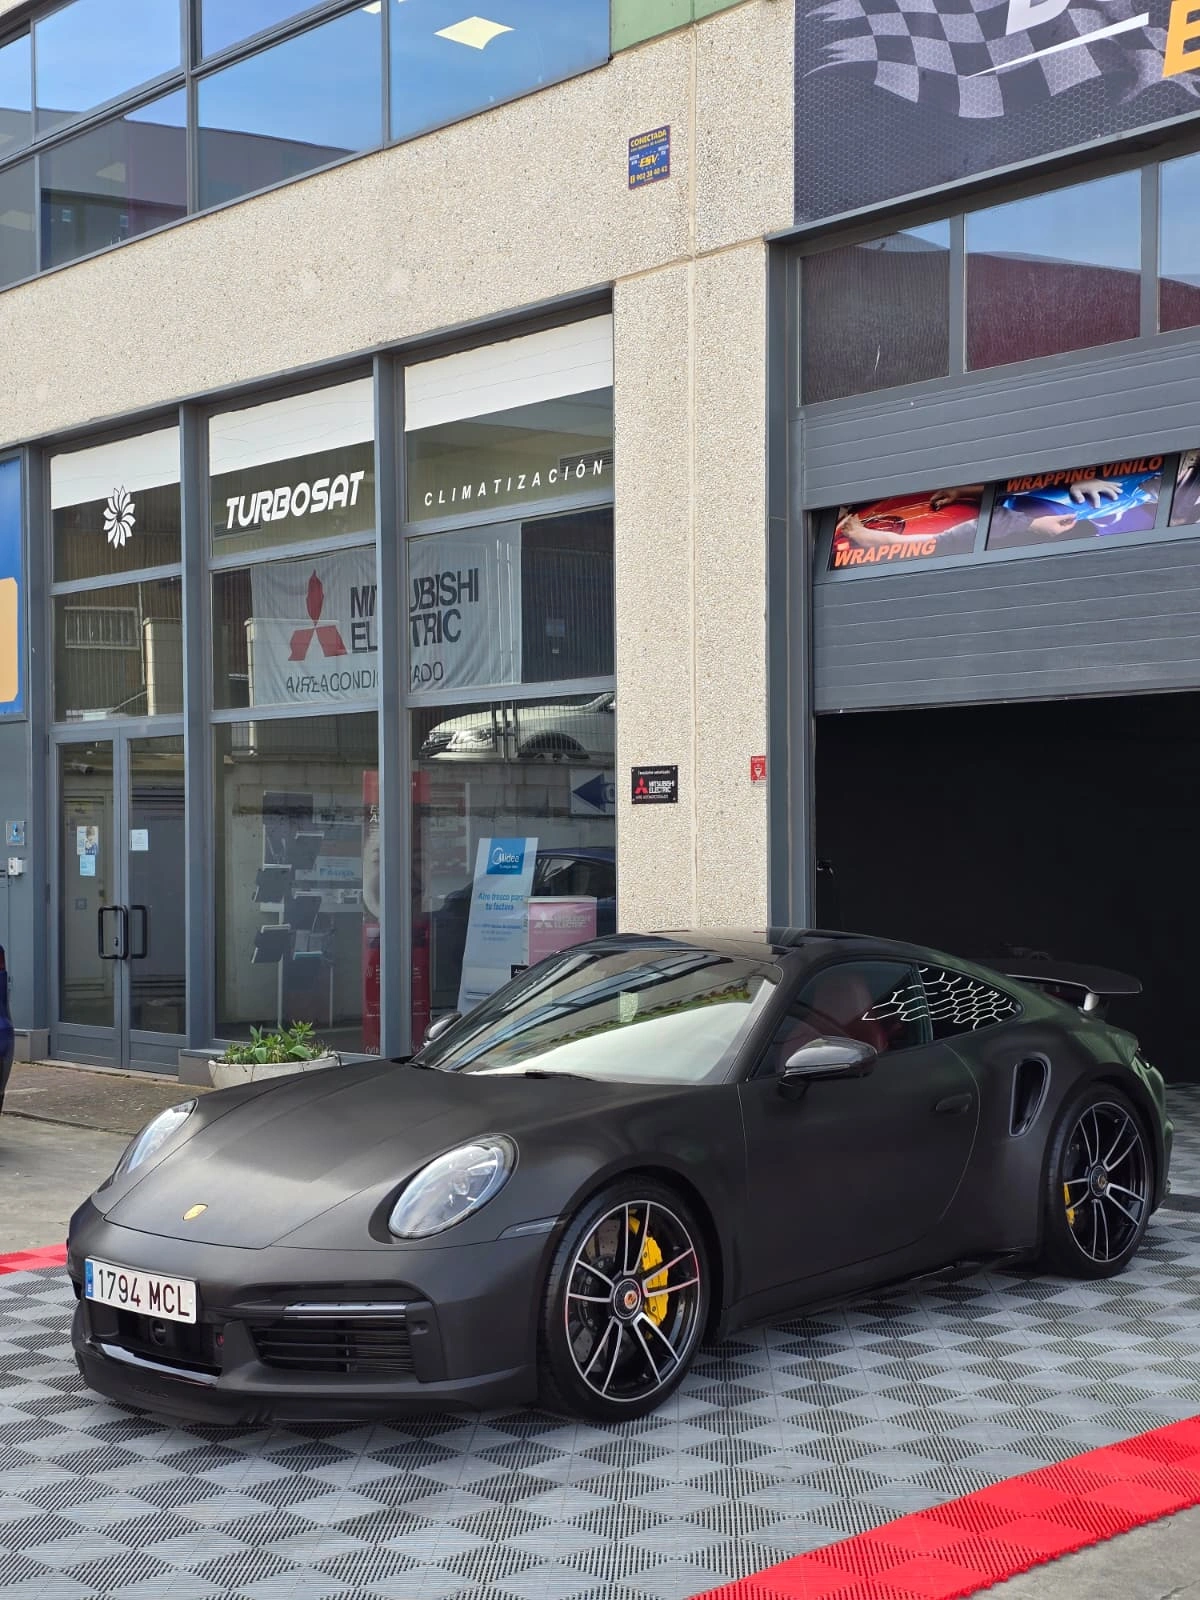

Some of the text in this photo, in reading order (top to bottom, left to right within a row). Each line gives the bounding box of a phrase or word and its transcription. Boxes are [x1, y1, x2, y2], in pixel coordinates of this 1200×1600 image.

[424, 459, 603, 507] CLIMATIZACIÓN
[1006, 456, 1163, 493] WRAPPING VINILO
[226, 470, 365, 529] TURBOSAT
[834, 538, 936, 568] WRAPPING
[351, 608, 462, 654] ELTRIC
[99, 1268, 190, 1317] 1794 MCL
